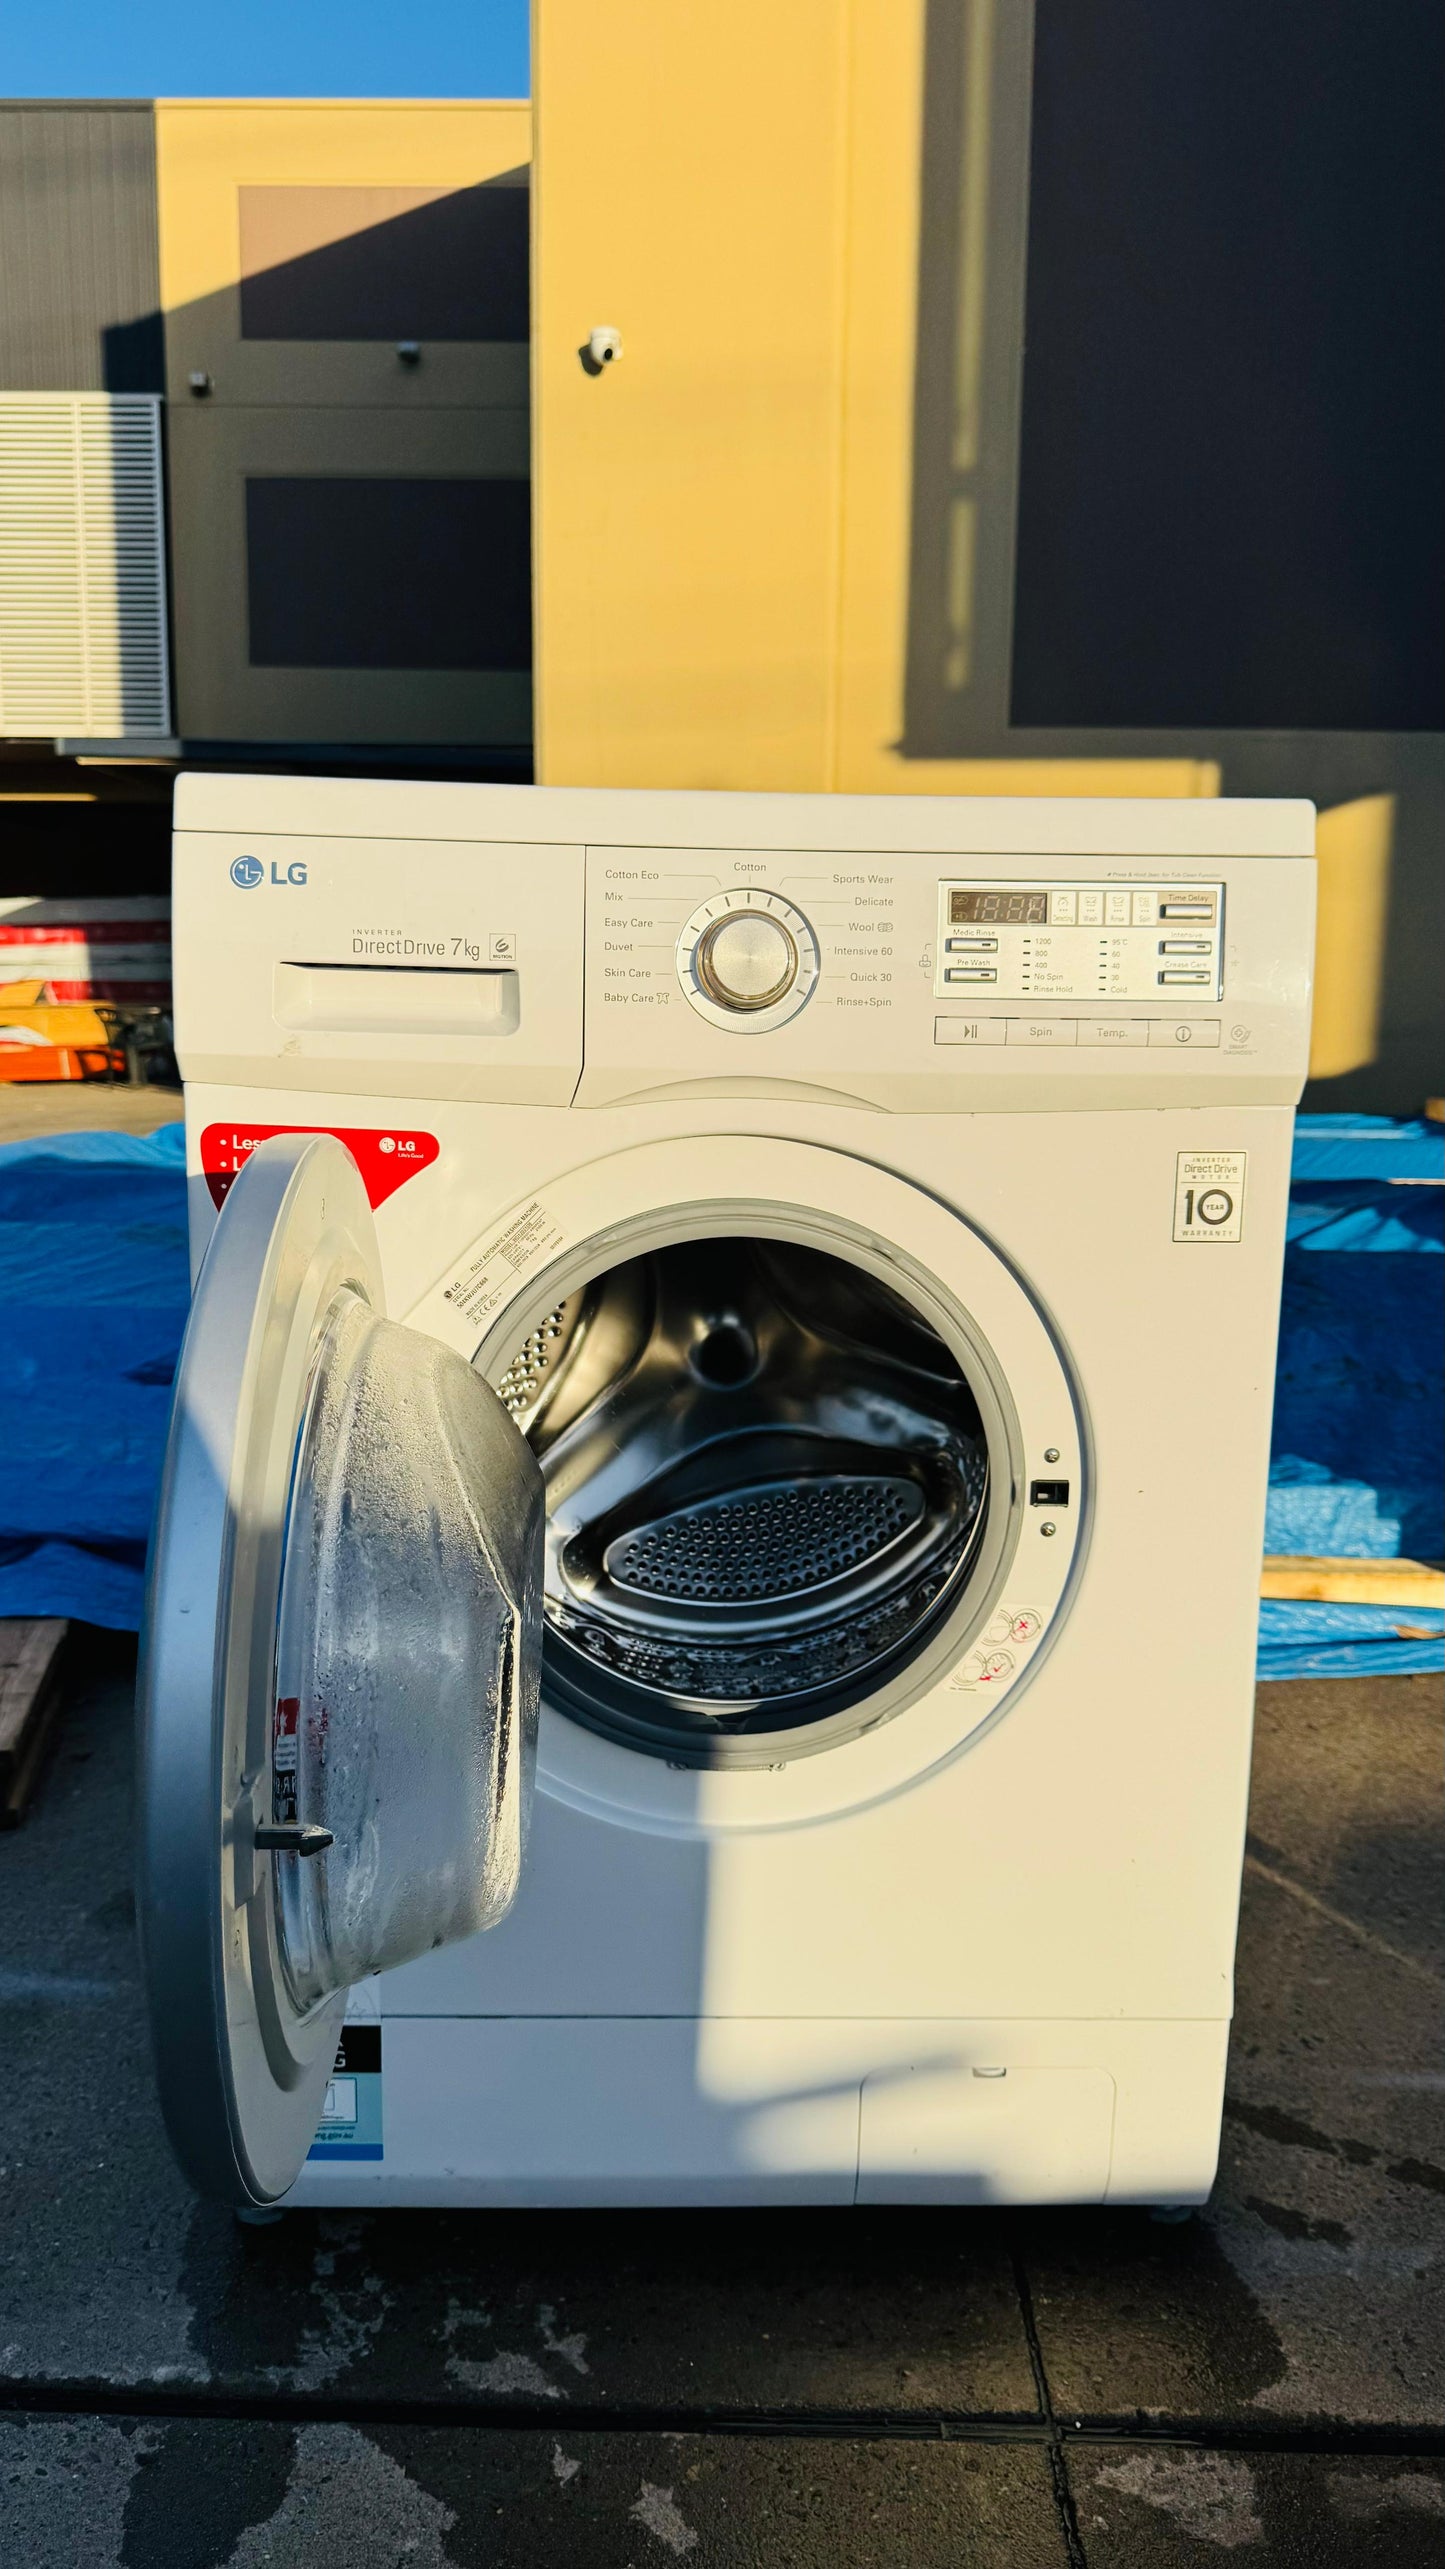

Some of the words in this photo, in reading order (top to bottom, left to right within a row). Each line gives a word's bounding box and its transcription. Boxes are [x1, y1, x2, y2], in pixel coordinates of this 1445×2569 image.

[734, 862, 766, 872] Cotton
[271, 861, 307, 885] LG
[605, 869, 638, 879] Cotton
[641, 870, 660, 880] Eco
[833, 874, 865, 885] Sports
[868, 875, 894, 884] Wear
[605, 892, 624, 901] Mix
[855, 896, 894, 906] Delicate
[1168, 894, 1186, 902] Time
[1188, 894, 1209, 903] Delay
[604, 917, 628, 929] Easy
[631, 918, 654, 928] Care
[848, 922, 875, 932] Wool
[976, 929, 996, 937] Rinse
[604, 942, 633, 952] Duvet
[834, 946, 878, 956] Intensive
[881, 946, 893, 956] 60
[1111, 962, 1121, 970] 40
[604, 967, 626, 977] Skin
[628, 968, 652, 978] Care
[850, 972, 878, 982] Quick
[880, 973, 892, 982] 30
[1034, 973, 1045, 981] No
[1047, 974, 1064, 982] Spin
[1034, 985, 1054, 993] Rinse
[1055, 985, 1073, 993] Hold
[1111, 986, 1128, 994] Cold
[604, 992, 629, 1004] Baby
[631, 993, 654, 1003] Care
[836, 996, 892, 1008] Rinse+Spin
[1029, 1026, 1053, 1037] Spin
[1097, 1028, 1129, 1039] Temp.
[397, 1140, 416, 1152] LG
[1184, 1163, 1212, 1174] Direct
[1214, 1164, 1238, 1174] Drive
[1184, 1188, 1234, 1226] 10
